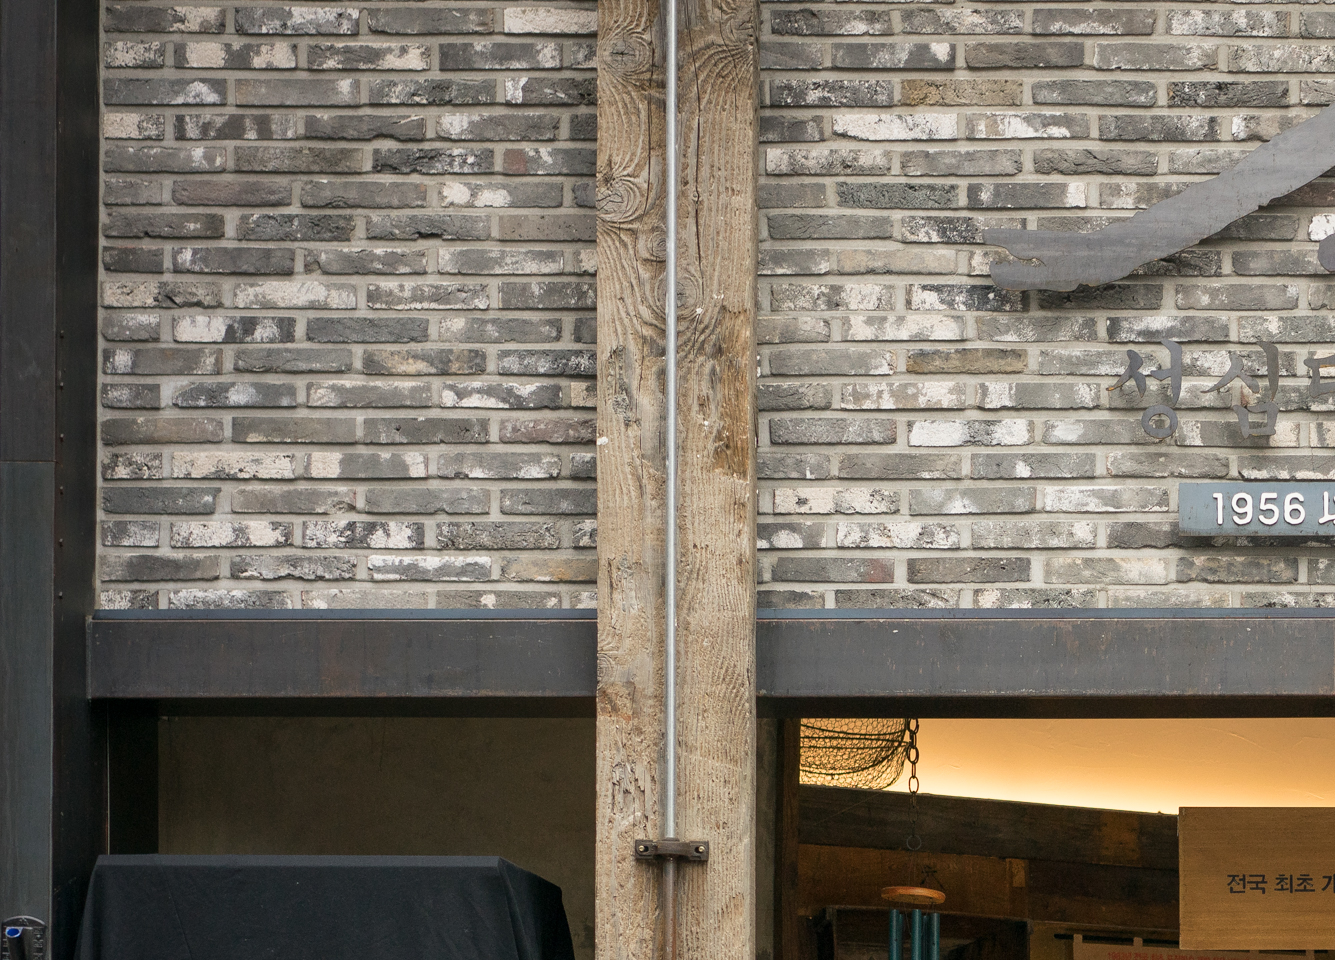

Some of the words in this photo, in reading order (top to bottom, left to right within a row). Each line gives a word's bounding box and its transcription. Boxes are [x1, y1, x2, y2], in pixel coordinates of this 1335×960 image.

[1212, 491, 1306, 527] 1956
[1226, 873, 1268, 894] 전국
[1274, 873, 1315, 894] 최초
